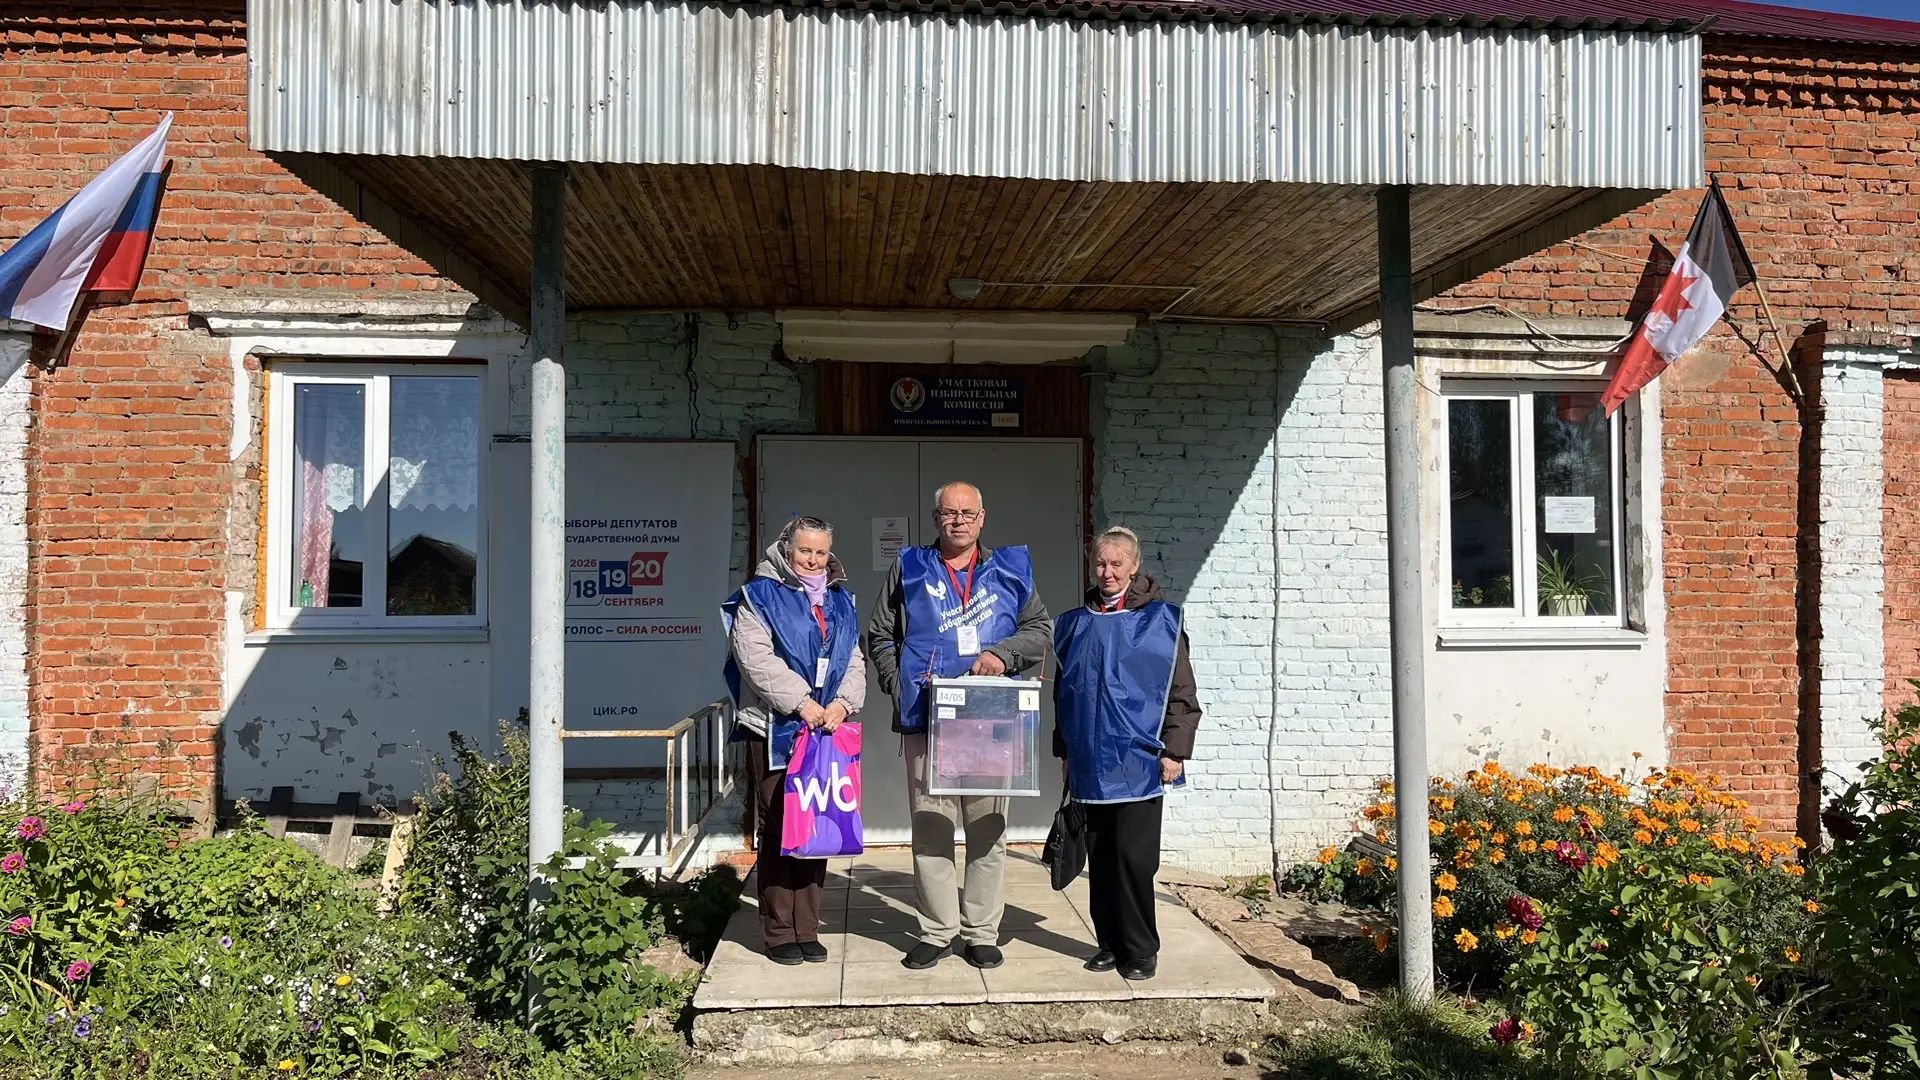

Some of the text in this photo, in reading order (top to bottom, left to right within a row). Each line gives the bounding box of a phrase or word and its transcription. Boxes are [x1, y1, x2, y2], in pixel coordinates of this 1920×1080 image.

[937, 378, 1008, 388] УЧАСТКОВАЯ
[930, 389, 1018, 399] ИЗБИРАТЕЛЬНАЯ
[944, 401, 1004, 409] КОМИССИЯ
[564, 519, 678, 530] ЫБОРЫ ДЕПУТАТОВ
[565, 534, 680, 545] СУДАРСТВЕННОЙ ДУМЫ
[570, 559, 597, 568] 2026
[573, 560, 661, 598] 18 19 20
[604, 597, 664, 607] СЕНТЯБРЯ
[564, 625, 603, 635] ГОЛОС
[616, 625, 648, 635] СИЛА
[650, 625, 702, 634] РОССИИ!
[938, 692, 964, 702] 34/05
[593, 706, 639, 717] ЦИК.РФ
[793, 762, 857, 812] wb
